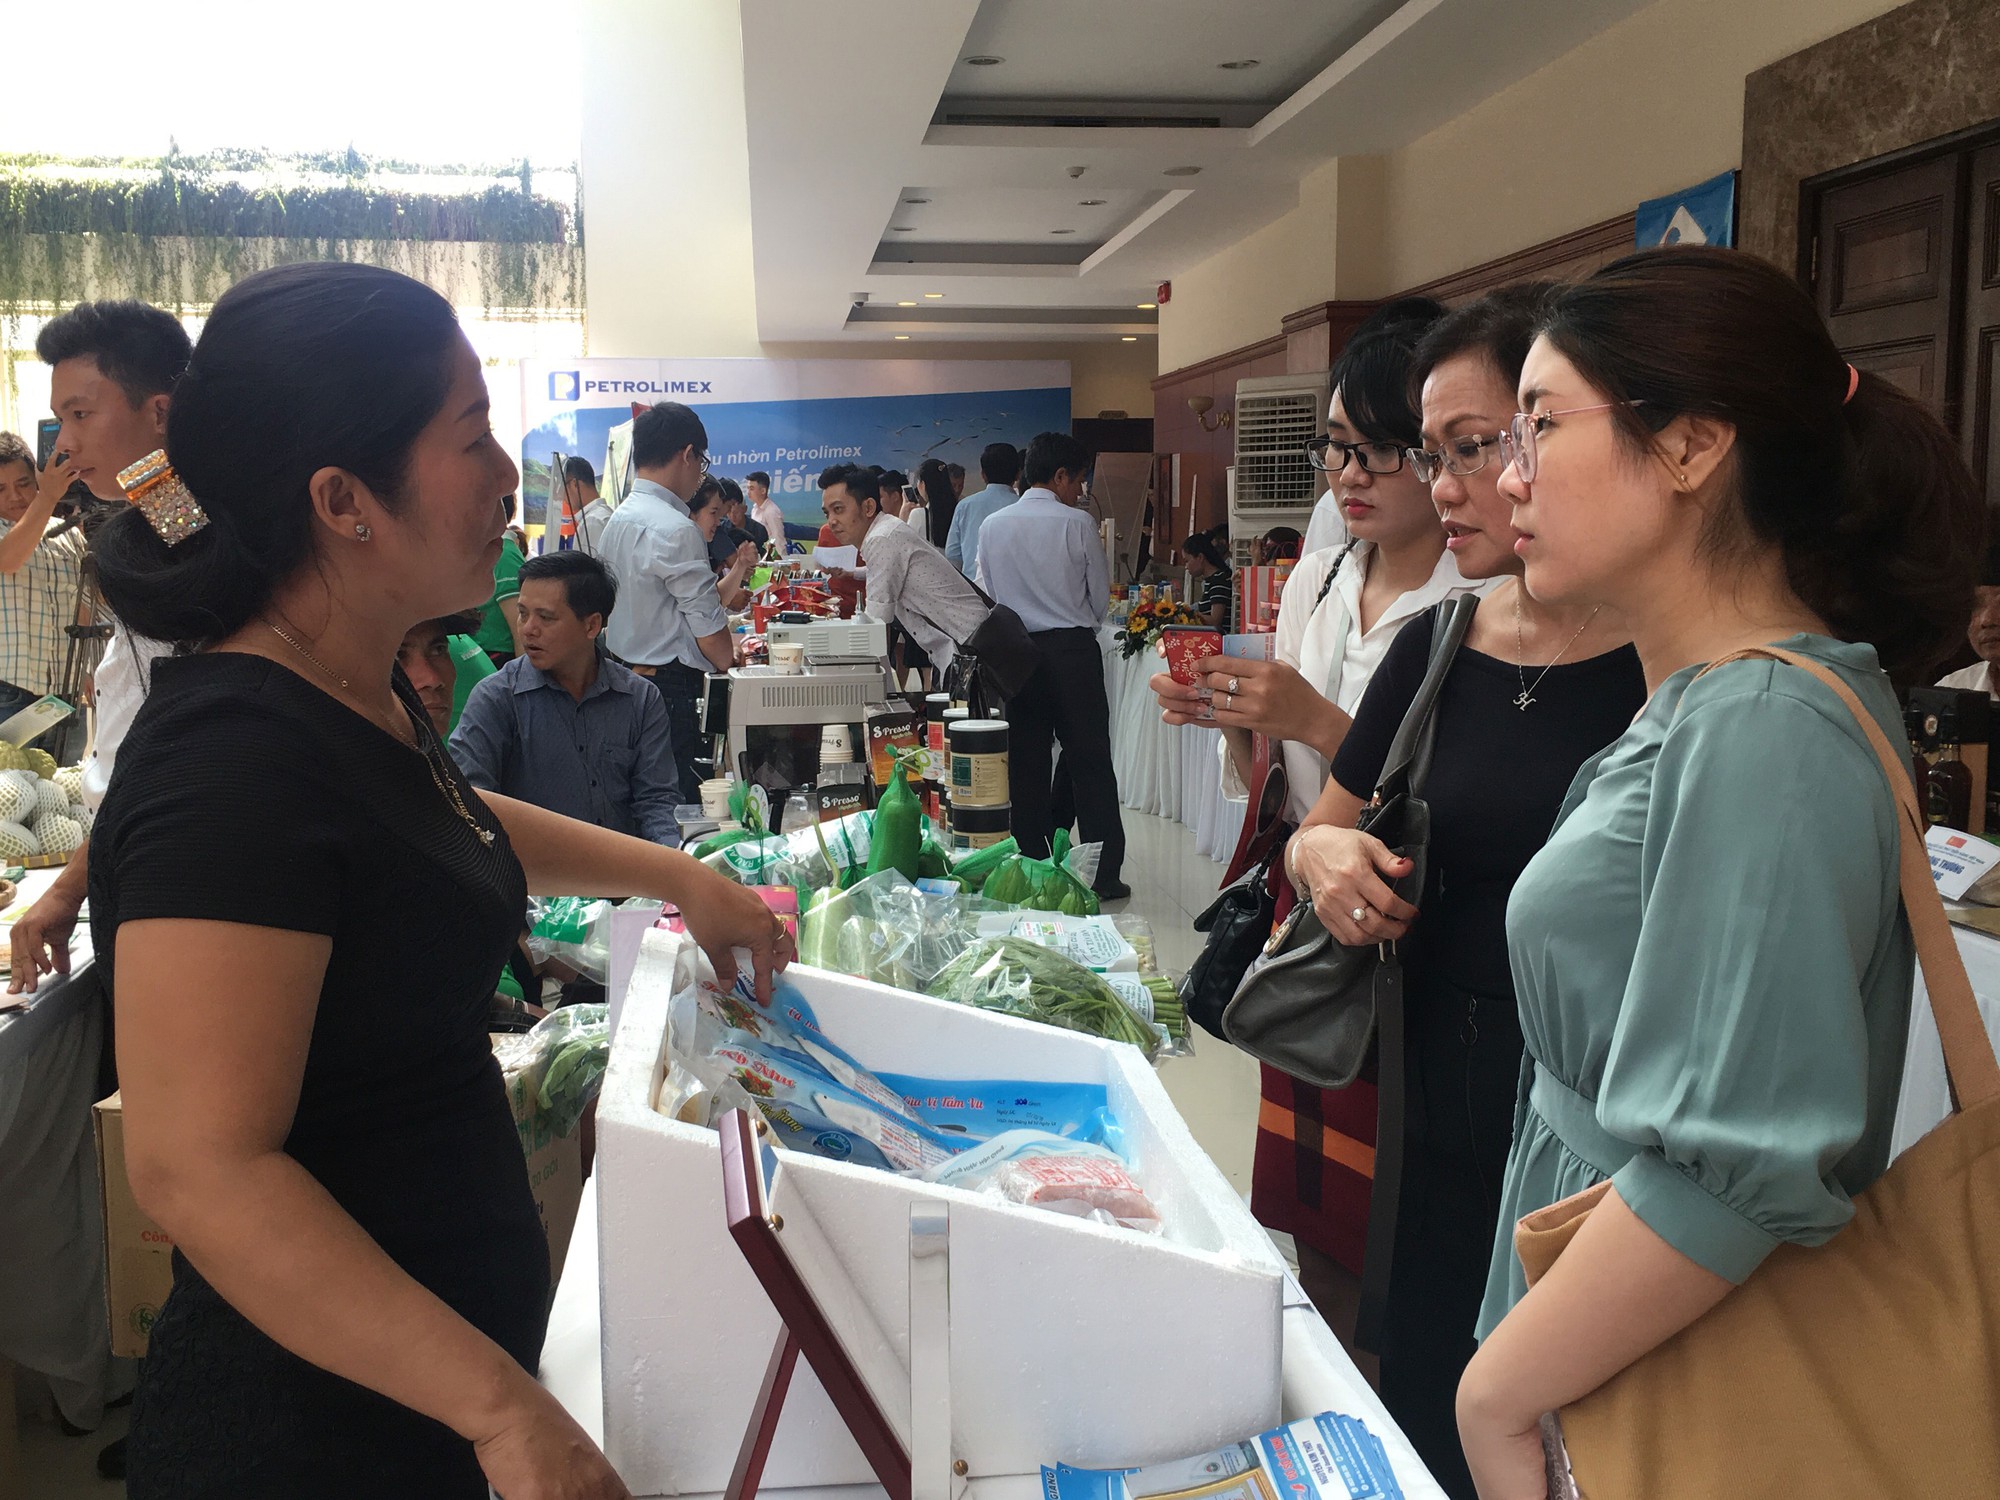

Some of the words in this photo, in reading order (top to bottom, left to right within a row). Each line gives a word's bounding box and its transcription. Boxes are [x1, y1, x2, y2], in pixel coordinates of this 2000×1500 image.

[585, 380, 712, 393] PETROLIMEX
[727, 449, 770, 465] nhờn
[775, 444, 862, 462] Petrolimex
[767, 464, 823, 495] iến
[873, 725, 883, 739] S
[882, 724, 911, 736] Presso
[822, 796, 832, 809] S
[831, 795, 860, 807] Presso
[734, 853, 755, 869] RAU
[1308, 1452, 1321, 1463] KIM
[1049, 1472, 1057, 1500] GIANG
